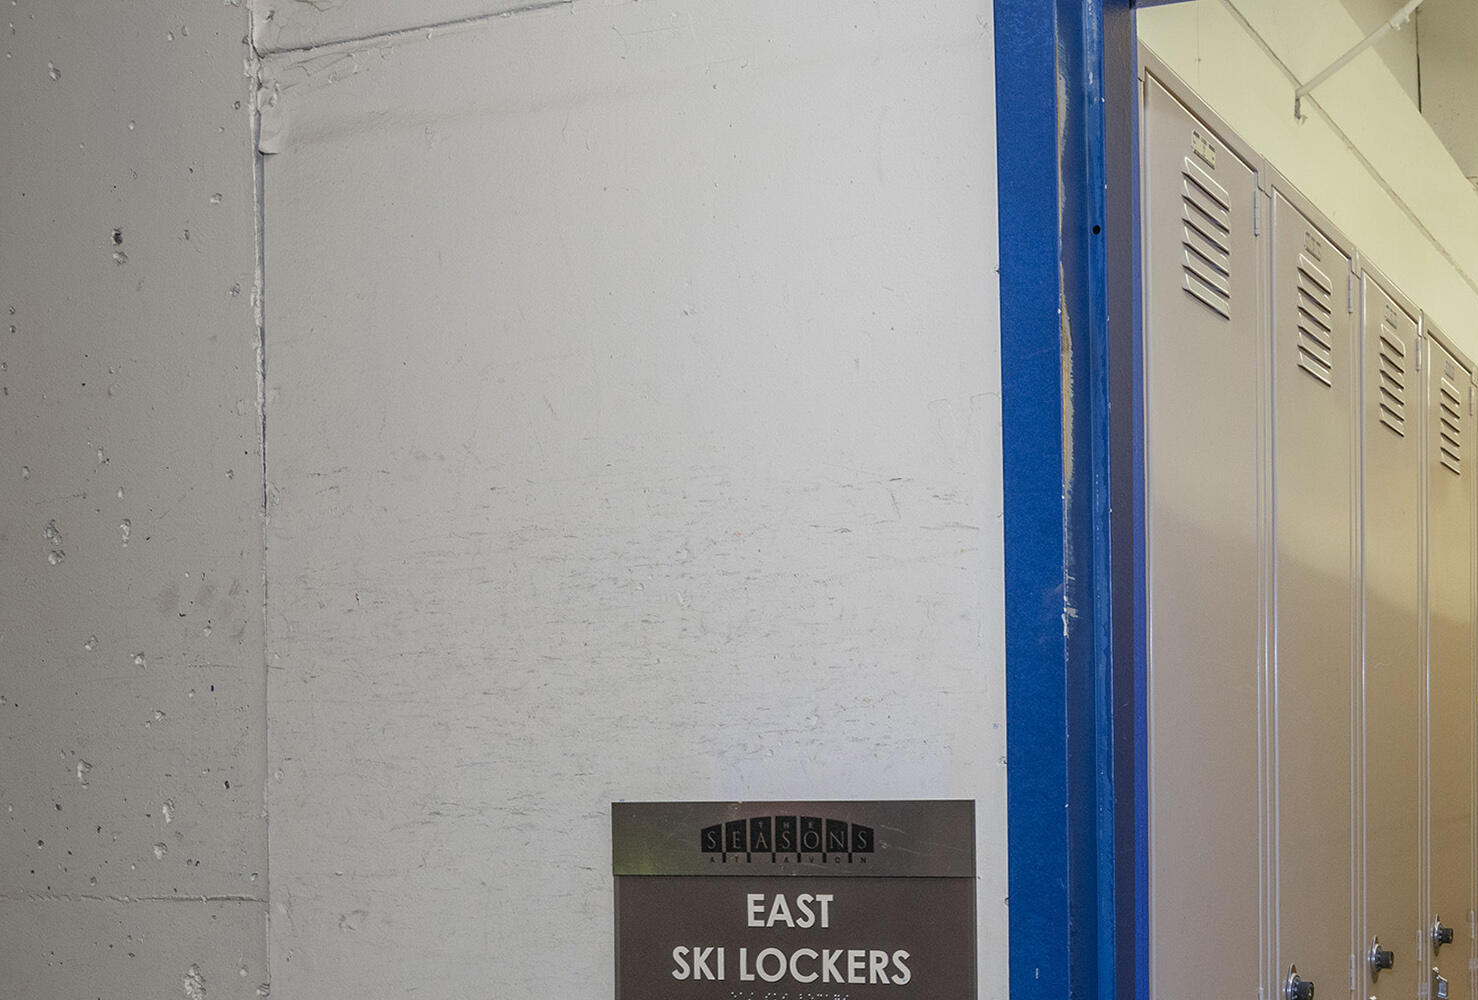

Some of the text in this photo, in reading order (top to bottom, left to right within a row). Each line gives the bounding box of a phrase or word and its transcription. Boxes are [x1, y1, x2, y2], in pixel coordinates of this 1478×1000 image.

[758, 821, 814, 829] THE
[706, 830, 868, 850] SEASONS
[746, 893, 834, 929] EAST
[671, 945, 912, 986] SKI LOCKERS
